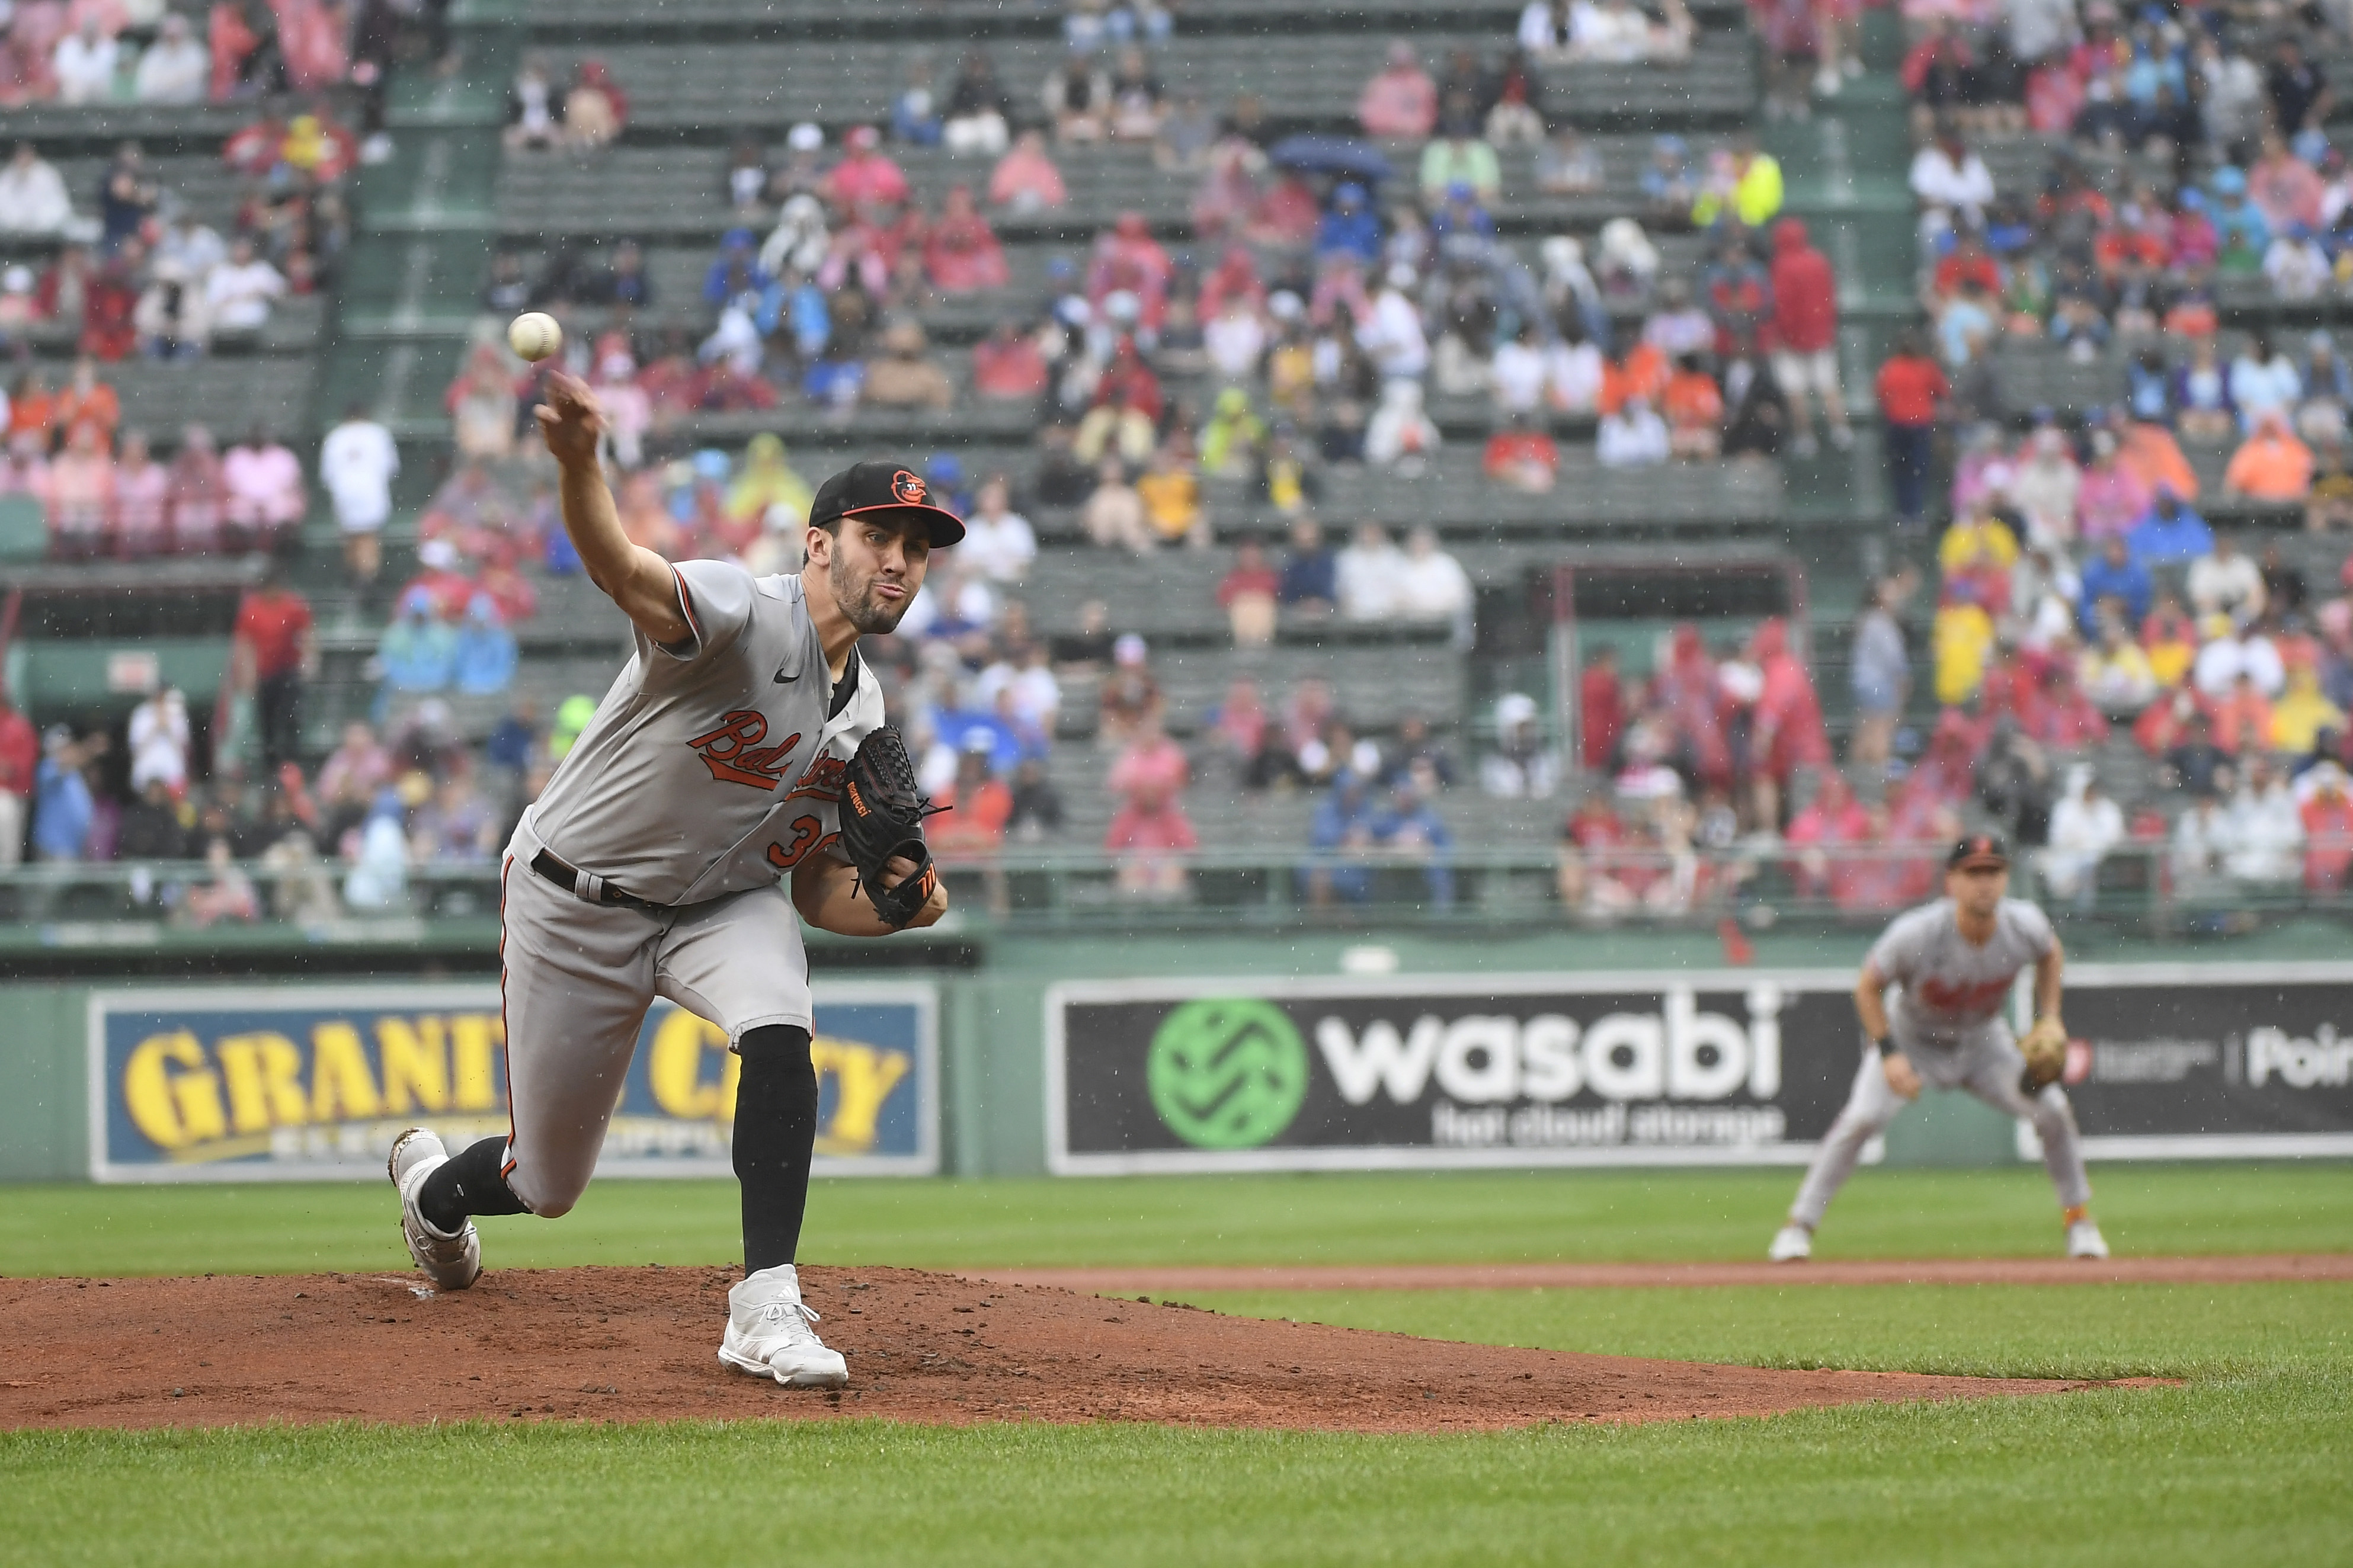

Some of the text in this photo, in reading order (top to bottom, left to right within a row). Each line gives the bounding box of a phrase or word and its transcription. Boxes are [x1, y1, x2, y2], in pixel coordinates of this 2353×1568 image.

[767, 814, 838, 868] 3
[123, 1012, 625, 1150] GRANI
[1314, 979, 1782, 1105] wasabi
